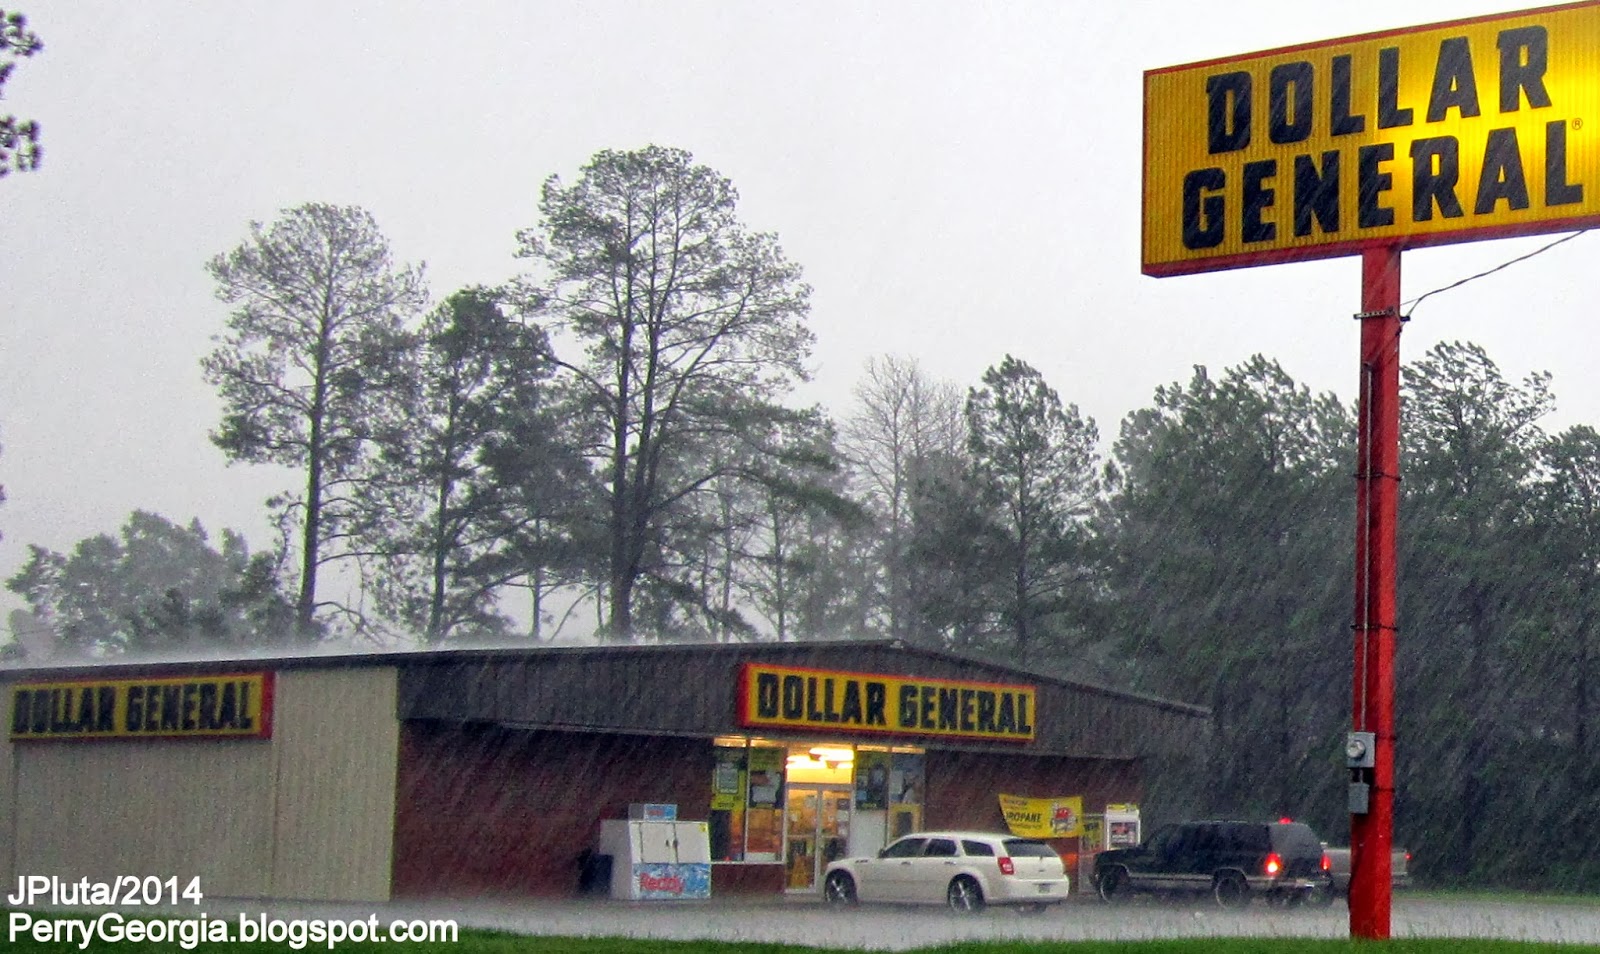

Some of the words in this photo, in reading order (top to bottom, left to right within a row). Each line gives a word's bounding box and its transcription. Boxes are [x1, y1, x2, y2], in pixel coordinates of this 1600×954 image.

[1206, 25, 1552, 154] DOLLAR
[1182, 119, 1583, 250] GENERAL
[13, 686, 116, 733] DOLLAR
[126, 681, 253, 731] GENERAL
[757, 672, 887, 725] DOLLAR
[900, 684, 1031, 733] GENERAL
